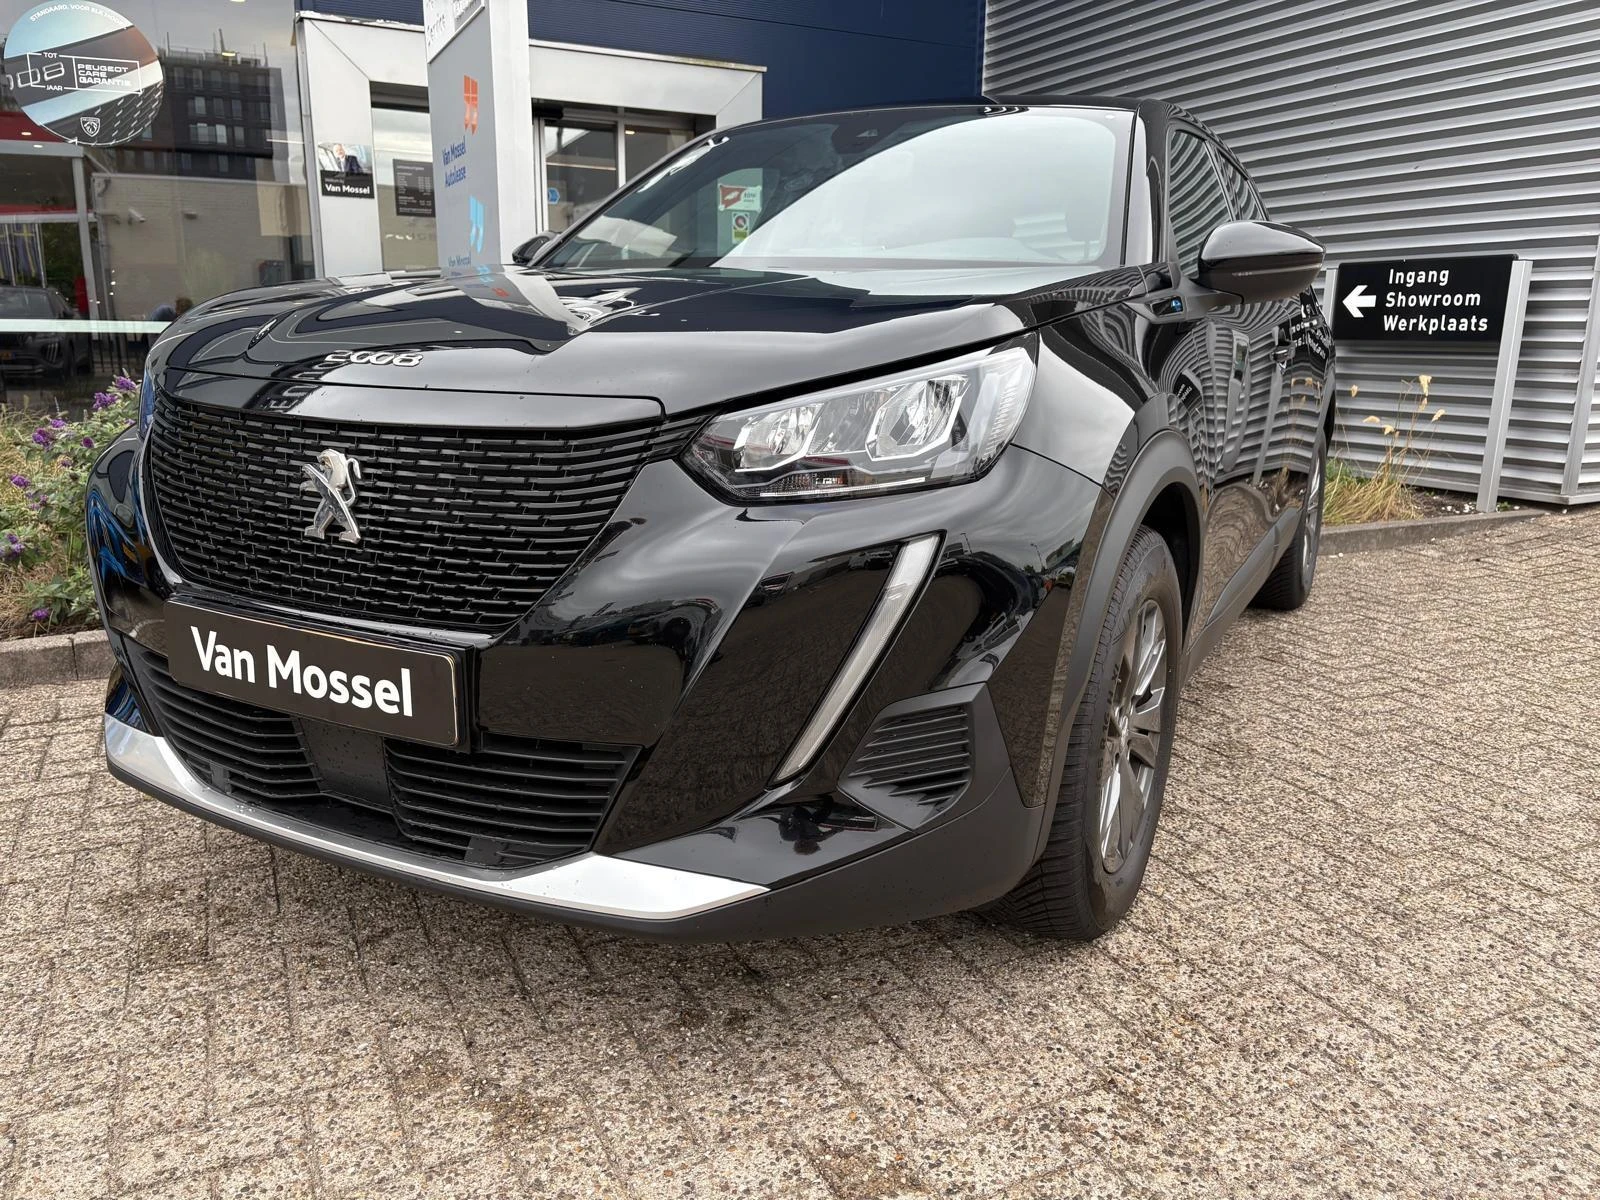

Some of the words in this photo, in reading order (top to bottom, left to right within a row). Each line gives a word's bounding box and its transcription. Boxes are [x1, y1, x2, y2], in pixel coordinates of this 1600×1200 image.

[77, 63, 129, 73] PEUGEOT
[78, 70, 108, 78] CARE
[79, 77, 132, 87] GARANTIE
[451, 135, 467, 158] Mossel
[445, 165, 467, 188] Autolease
[325, 183, 341, 192] Van
[342, 185, 370, 194] Mossel
[1388, 268, 1449, 287] Ingang
[1385, 292, 1481, 308] Showroom
[1383, 314, 1488, 335] Werkplaats
[324, 350, 423, 367] 2008
[190, 625, 256, 684] Van
[266, 644, 413, 717] Mossel
